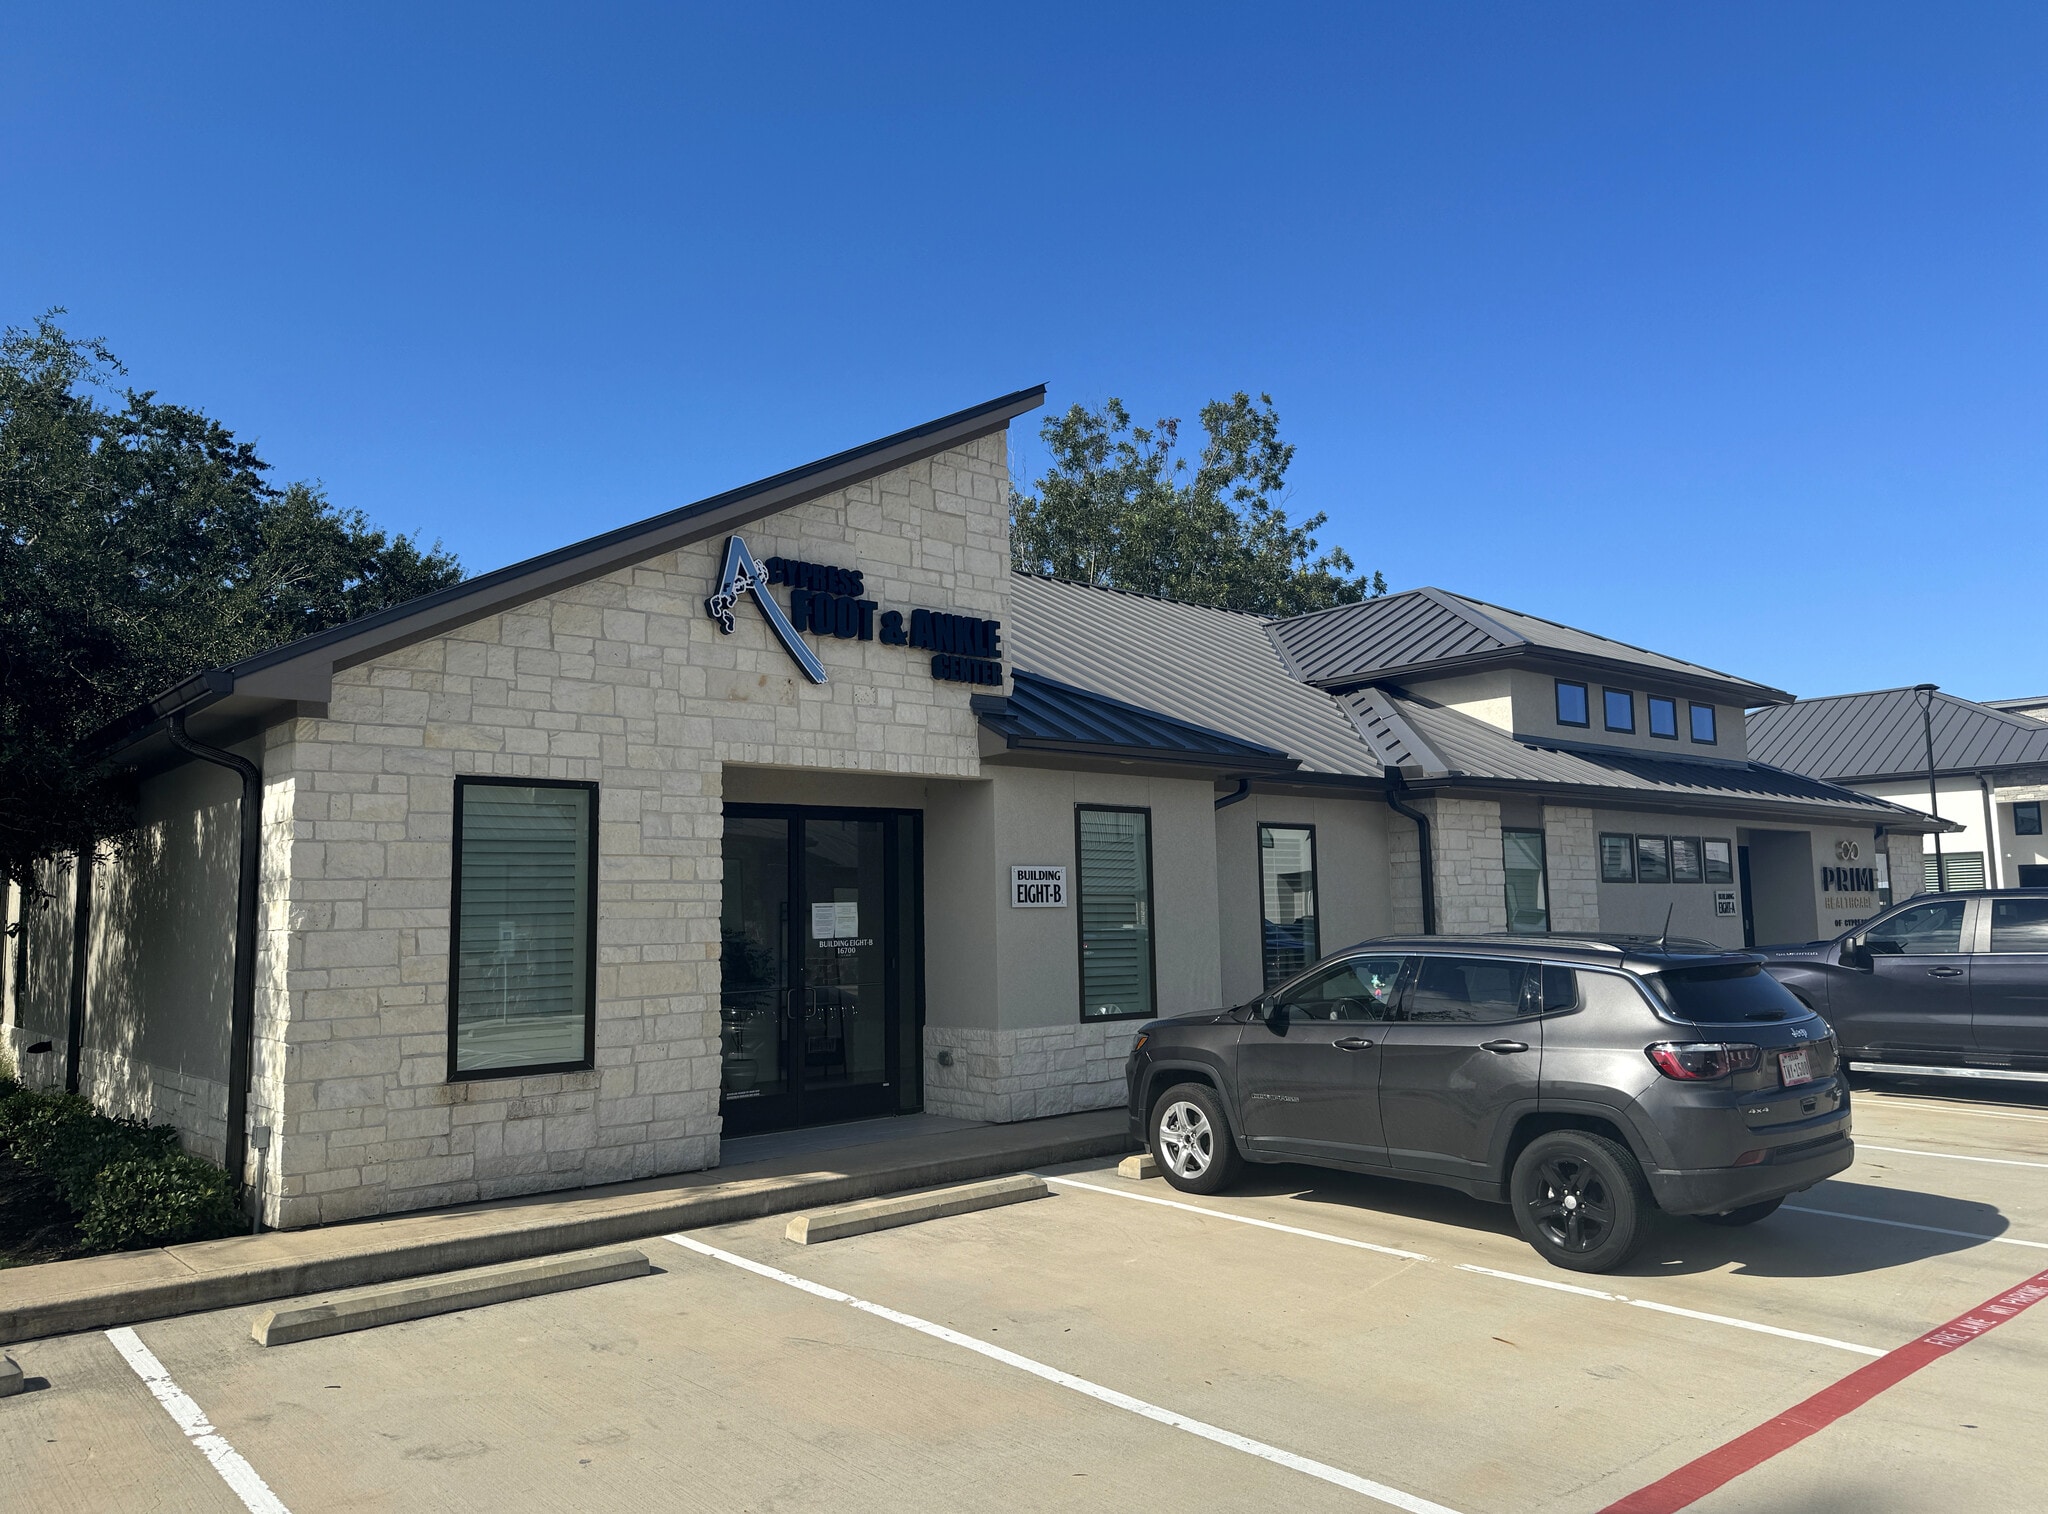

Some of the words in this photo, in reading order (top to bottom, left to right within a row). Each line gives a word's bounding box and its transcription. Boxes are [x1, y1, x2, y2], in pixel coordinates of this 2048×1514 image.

[765, 556, 864, 596] CYPRESS
[790, 589, 878, 641] FOOT
[879, 610, 908, 646] &
[909, 608, 1001, 658] ANKLE
[931, 654, 1003, 686] CENTER
[1017, 870, 1061, 881] BUILDING
[1017, 884, 1062, 903] EIGHT-B
[1718, 901, 1736, 914] EIGHT-A
[1824, 897, 1872, 909] HEALTHCARE
[1835, 919, 1843, 927] OF
[819, 940, 849, 948] BUILDING
[1923, 1330, 1971, 1348] FIRE
[1949, 1316, 1997, 1334] LANE
